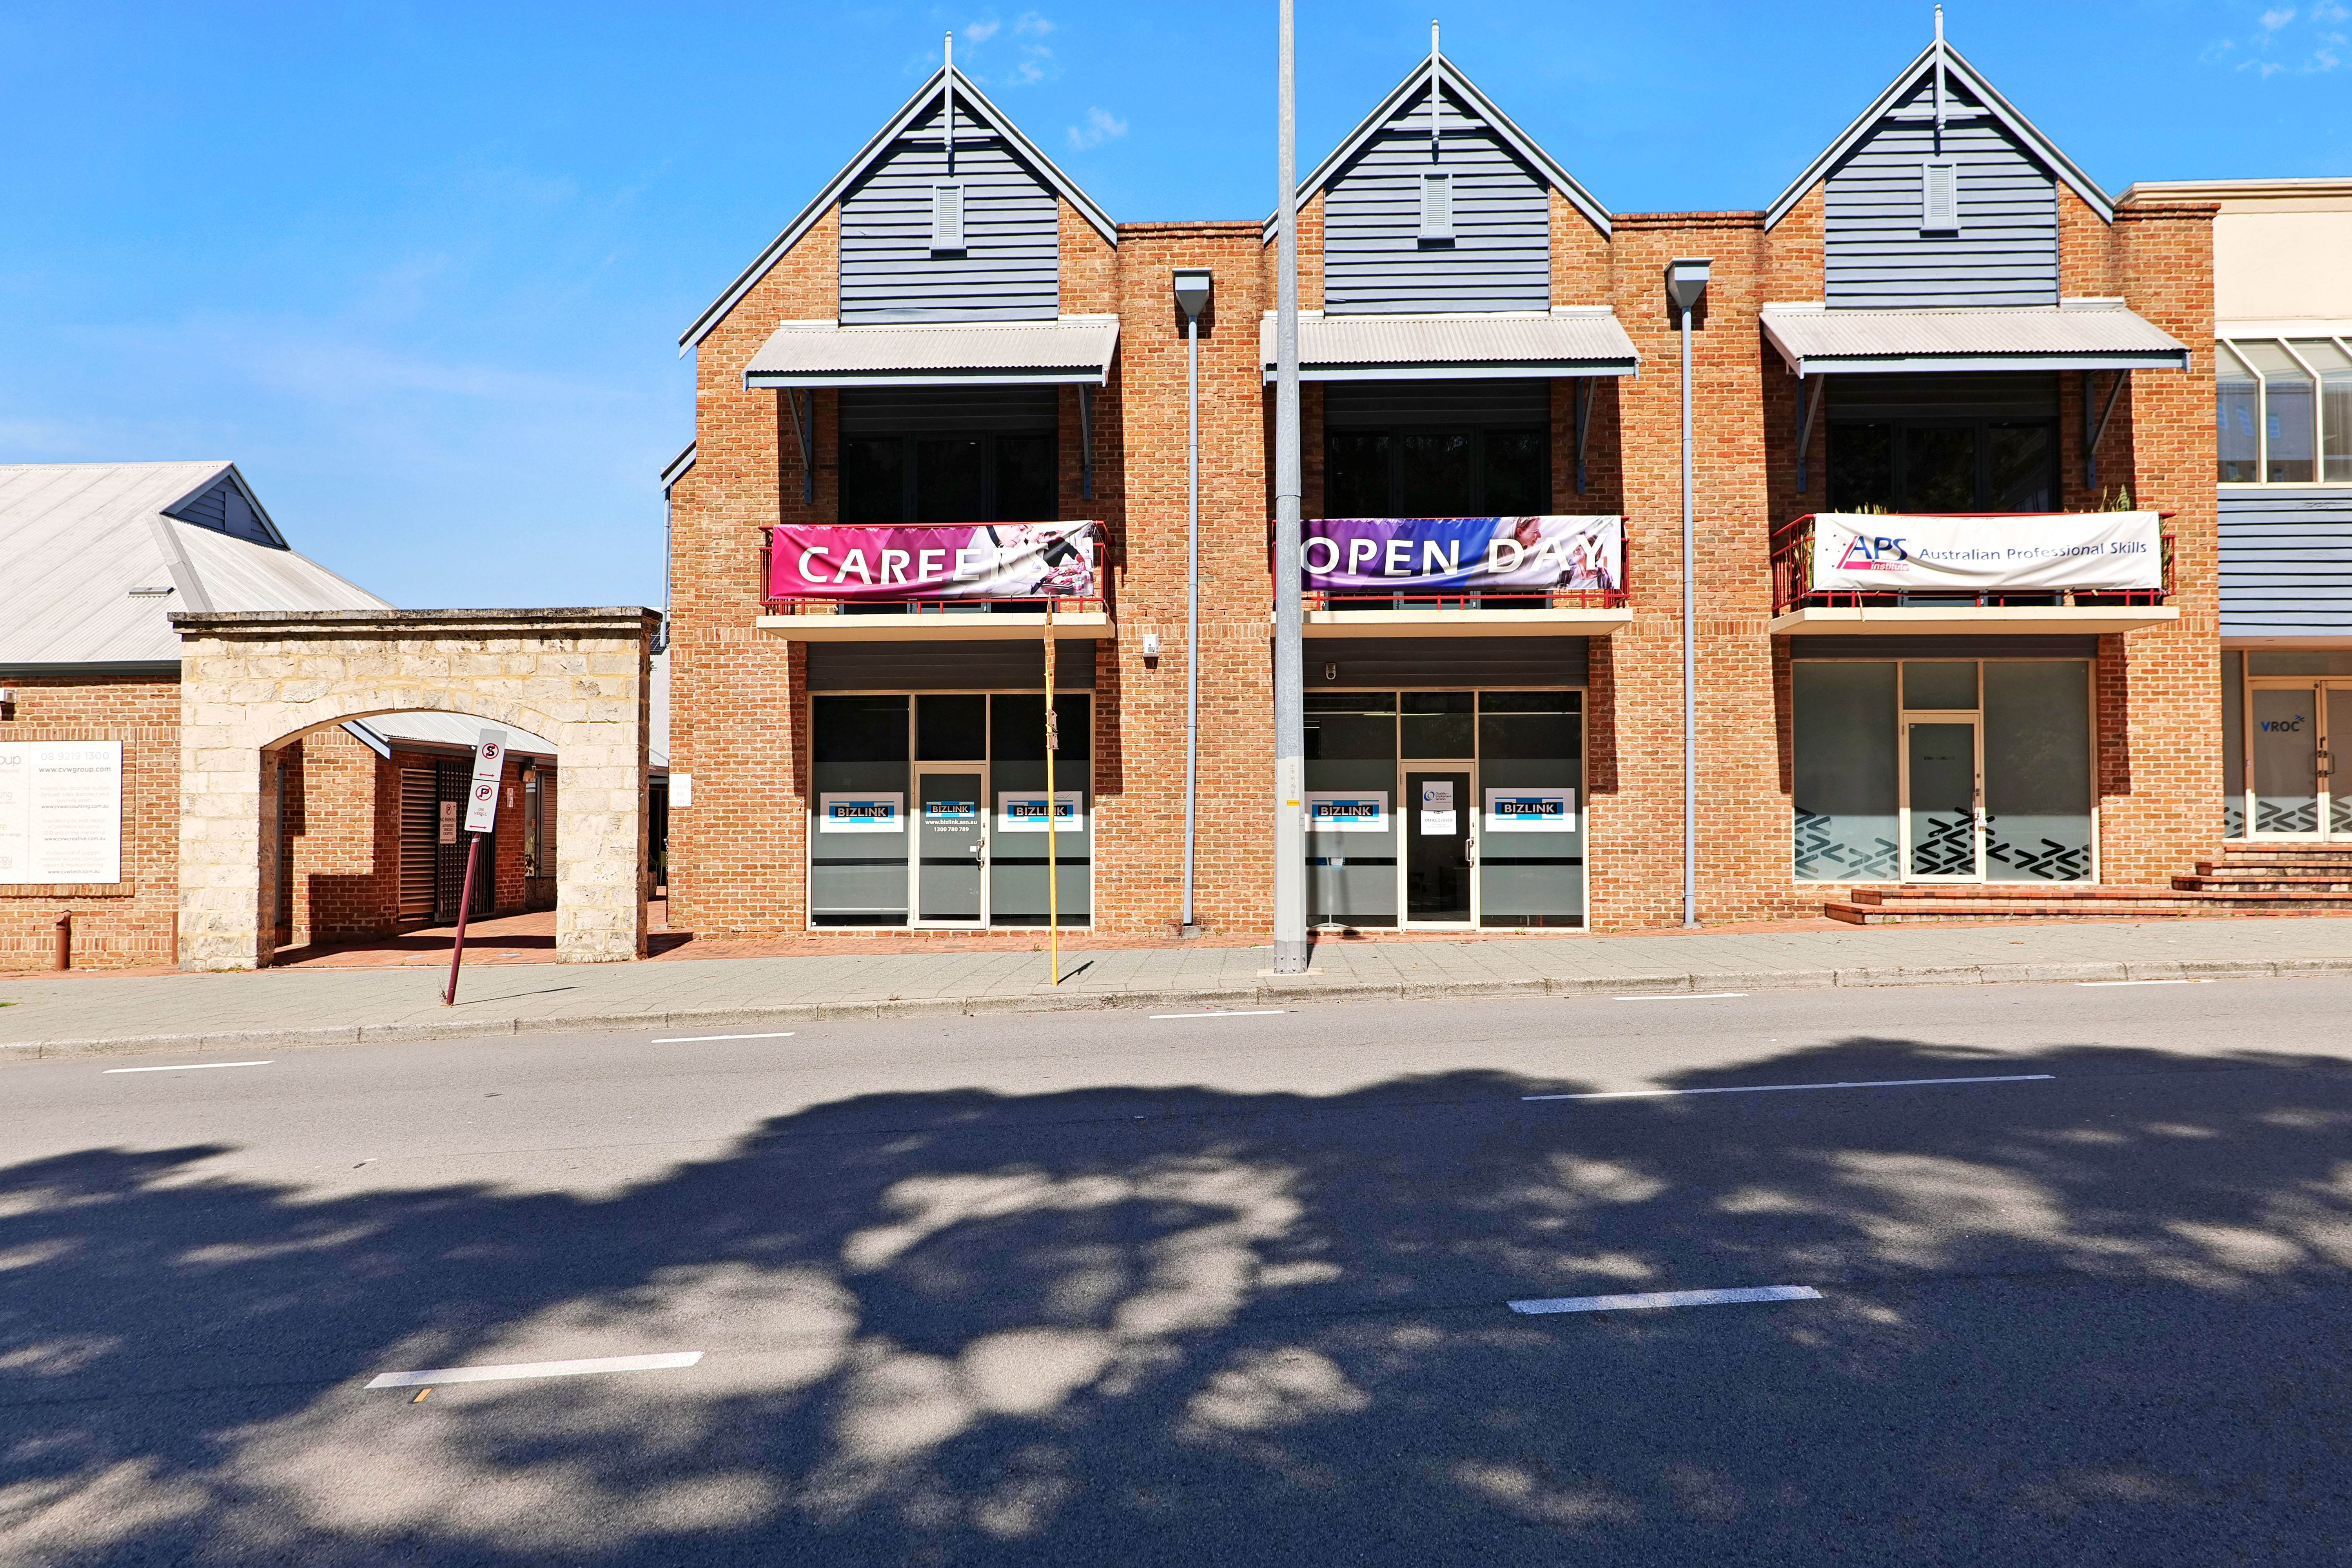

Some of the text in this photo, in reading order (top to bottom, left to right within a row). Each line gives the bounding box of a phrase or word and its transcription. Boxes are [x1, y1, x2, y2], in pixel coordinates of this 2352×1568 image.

[1848, 536, 1908, 561] APS
[1919, 541, 2147, 561] Australian Professional Skills
[1301, 533, 1608, 576] OPEN DAY
[798, 543, 1050, 585] CAREERS
[1871, 561, 1909, 571] institute
[2261, 720, 2300, 732] VROC
[40, 752, 54, 760] 08
[837, 808, 886, 817] BIZLINK
[1320, 807, 1371, 816] BIZLINK
[1504, 804, 1554, 813] BIZLINK
